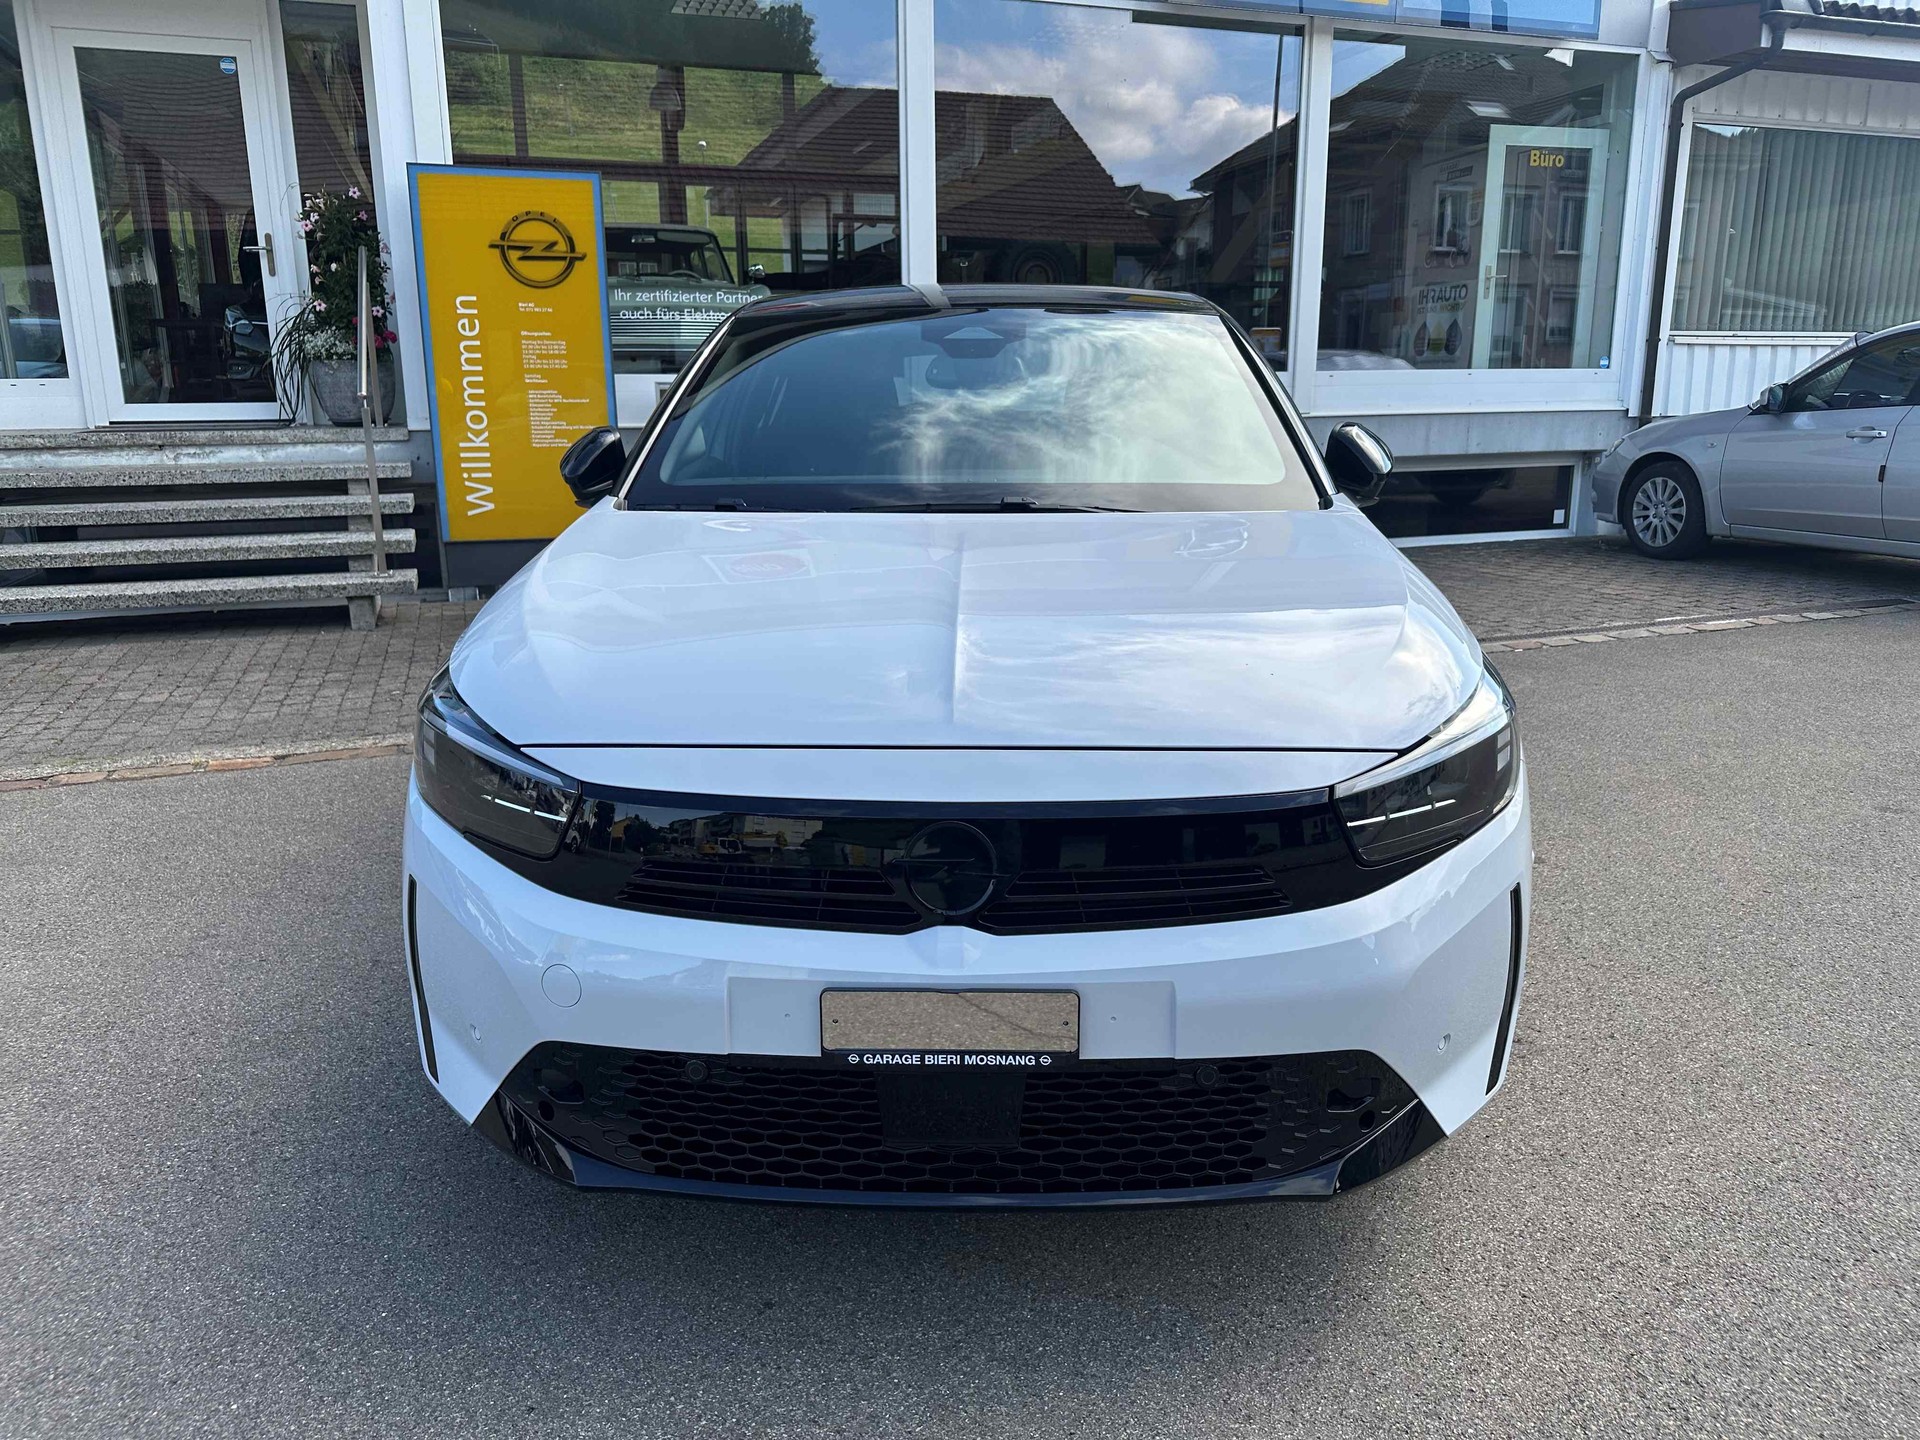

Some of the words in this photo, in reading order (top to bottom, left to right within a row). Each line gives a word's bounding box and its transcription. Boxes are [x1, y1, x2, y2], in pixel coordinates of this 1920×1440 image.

[1529, 149, 1565, 168] Büro
[512, 210, 558, 223] OPEL
[614, 289, 631, 301] Ihr
[636, 290, 713, 303] zertifizierter
[1418, 288, 1436, 305] IHR
[1436, 284, 1469, 303] AUTO
[619, 308, 655, 319] auch
[656, 307, 680, 321] fürs
[684, 308, 732, 321] Elektro
[455, 295, 496, 517] Willkommen
[863, 1054, 921, 1065] GARAGE
[924, 1054, 961, 1065] BIERI
[964, 1055, 1036, 1066] MOSNANG
